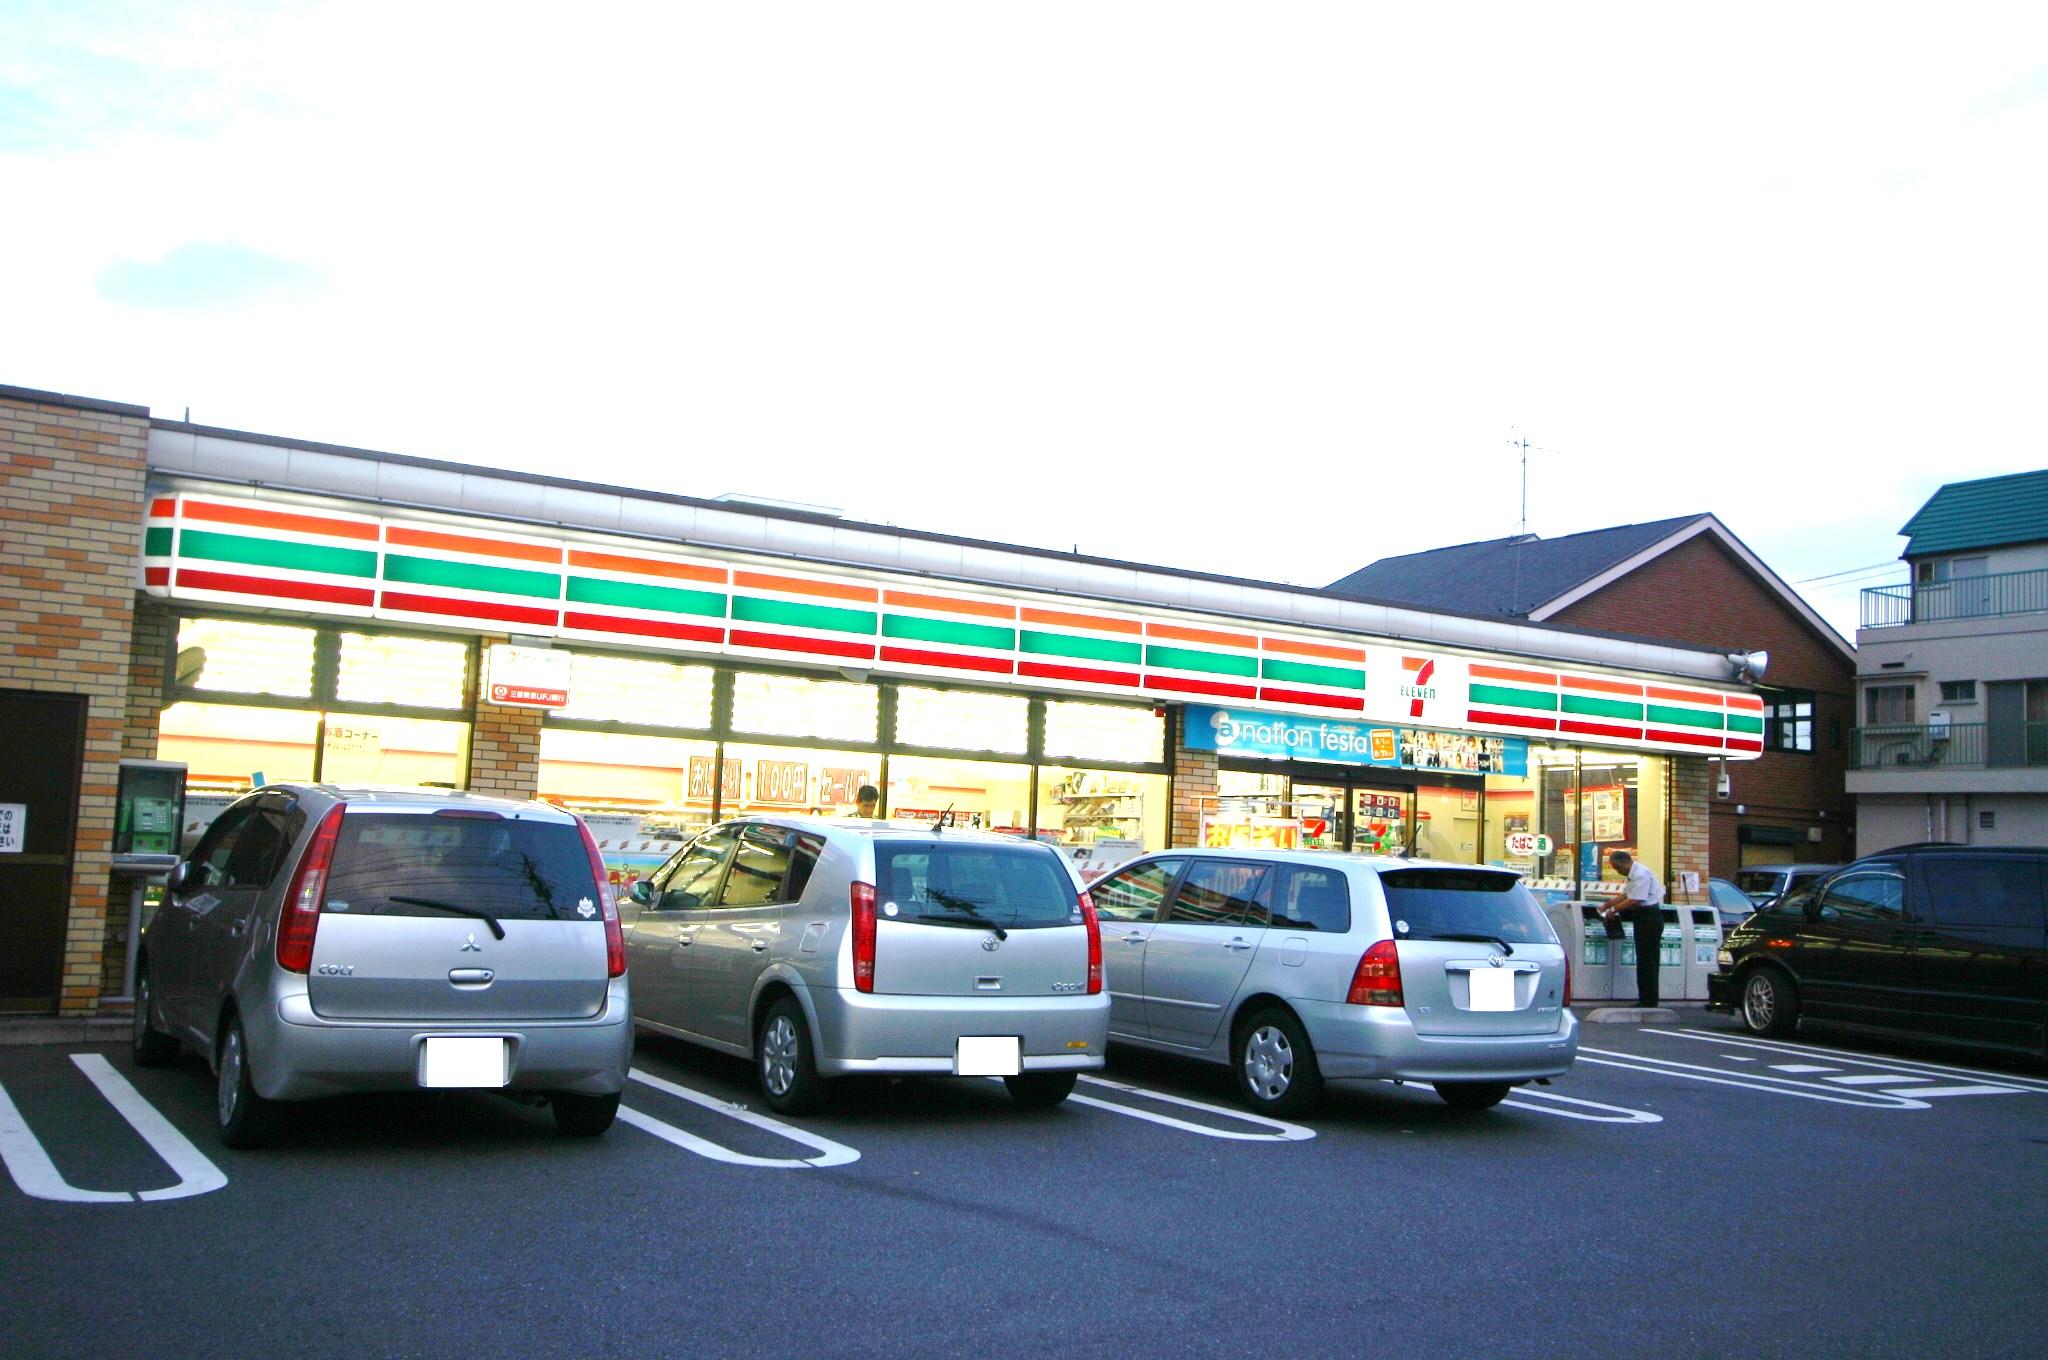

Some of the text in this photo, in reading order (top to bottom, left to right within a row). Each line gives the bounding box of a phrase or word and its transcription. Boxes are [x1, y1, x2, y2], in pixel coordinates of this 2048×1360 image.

[1242, 721, 1313, 748] nation
[1320, 723, 1368, 753] festa
[1511, 836, 1533, 850] たばこ
[318, 963, 354, 977] COLT
